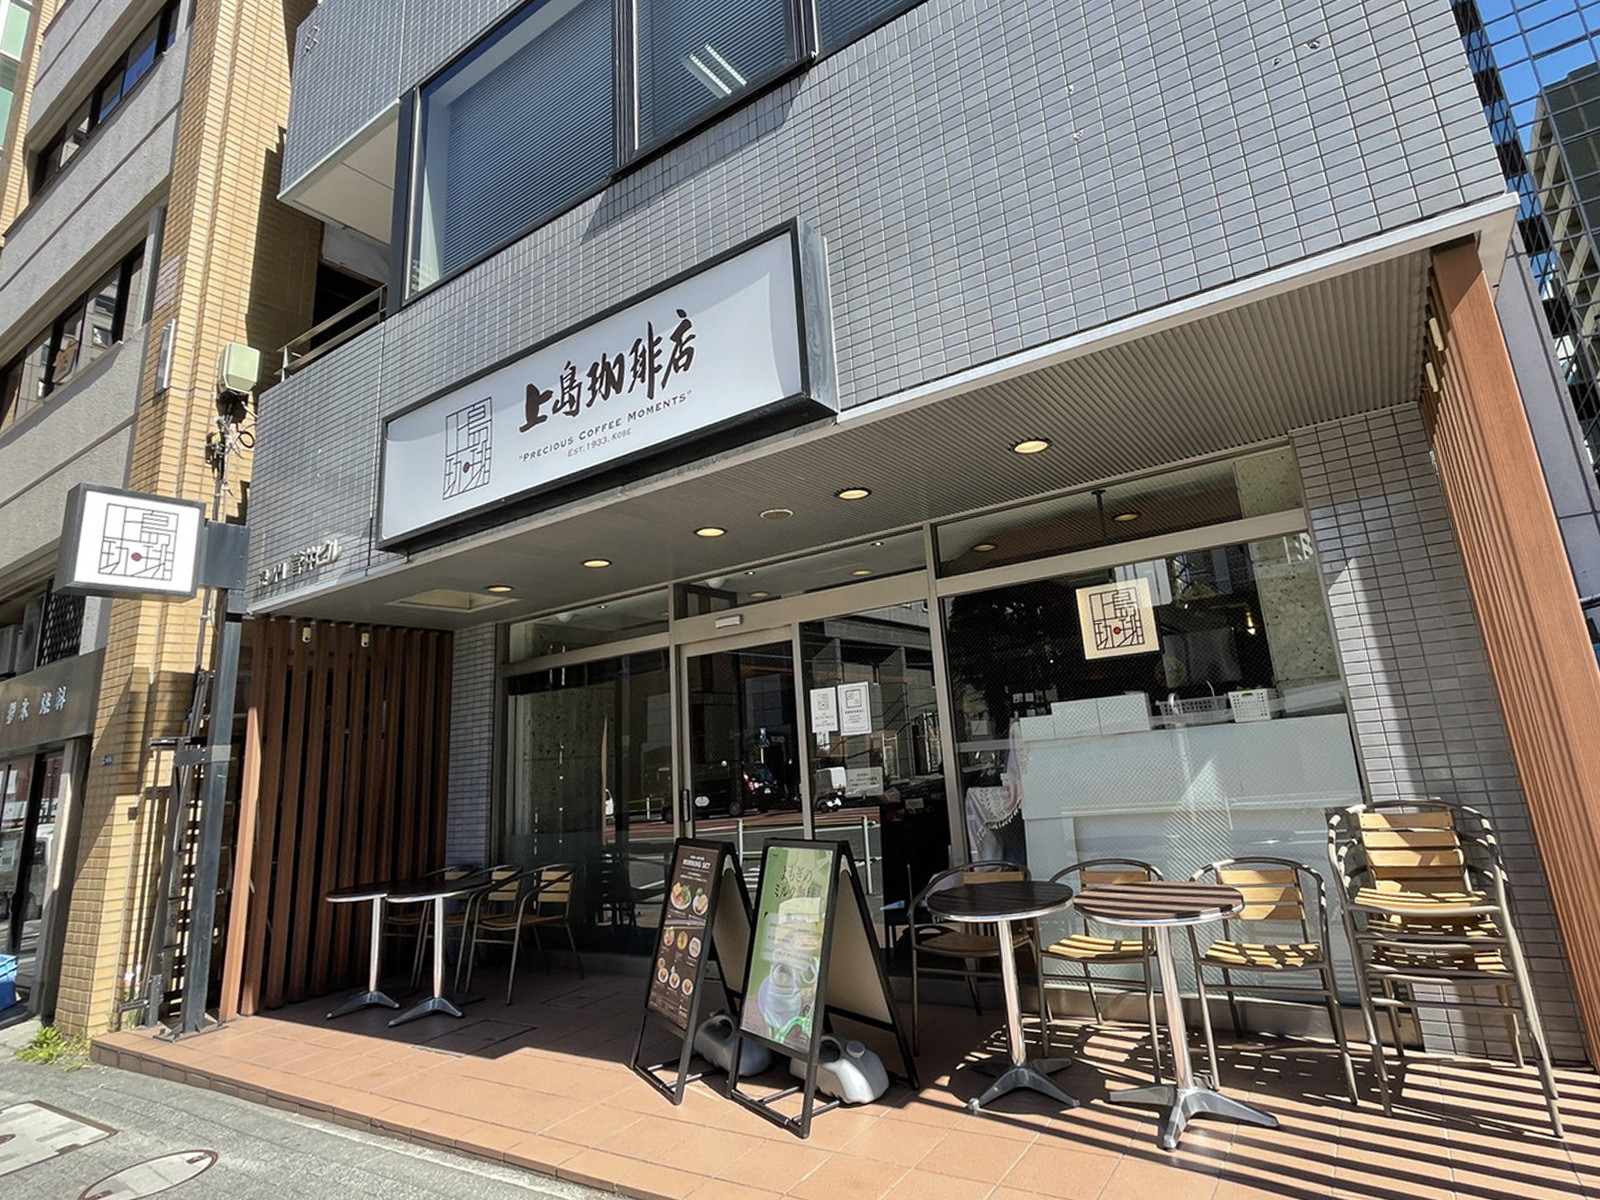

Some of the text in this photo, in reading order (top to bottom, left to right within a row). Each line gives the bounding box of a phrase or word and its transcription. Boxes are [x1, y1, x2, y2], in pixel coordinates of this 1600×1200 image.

[519, 308, 696, 433] 上島珈琲店
[578, 418, 622, 441] COFFEE
